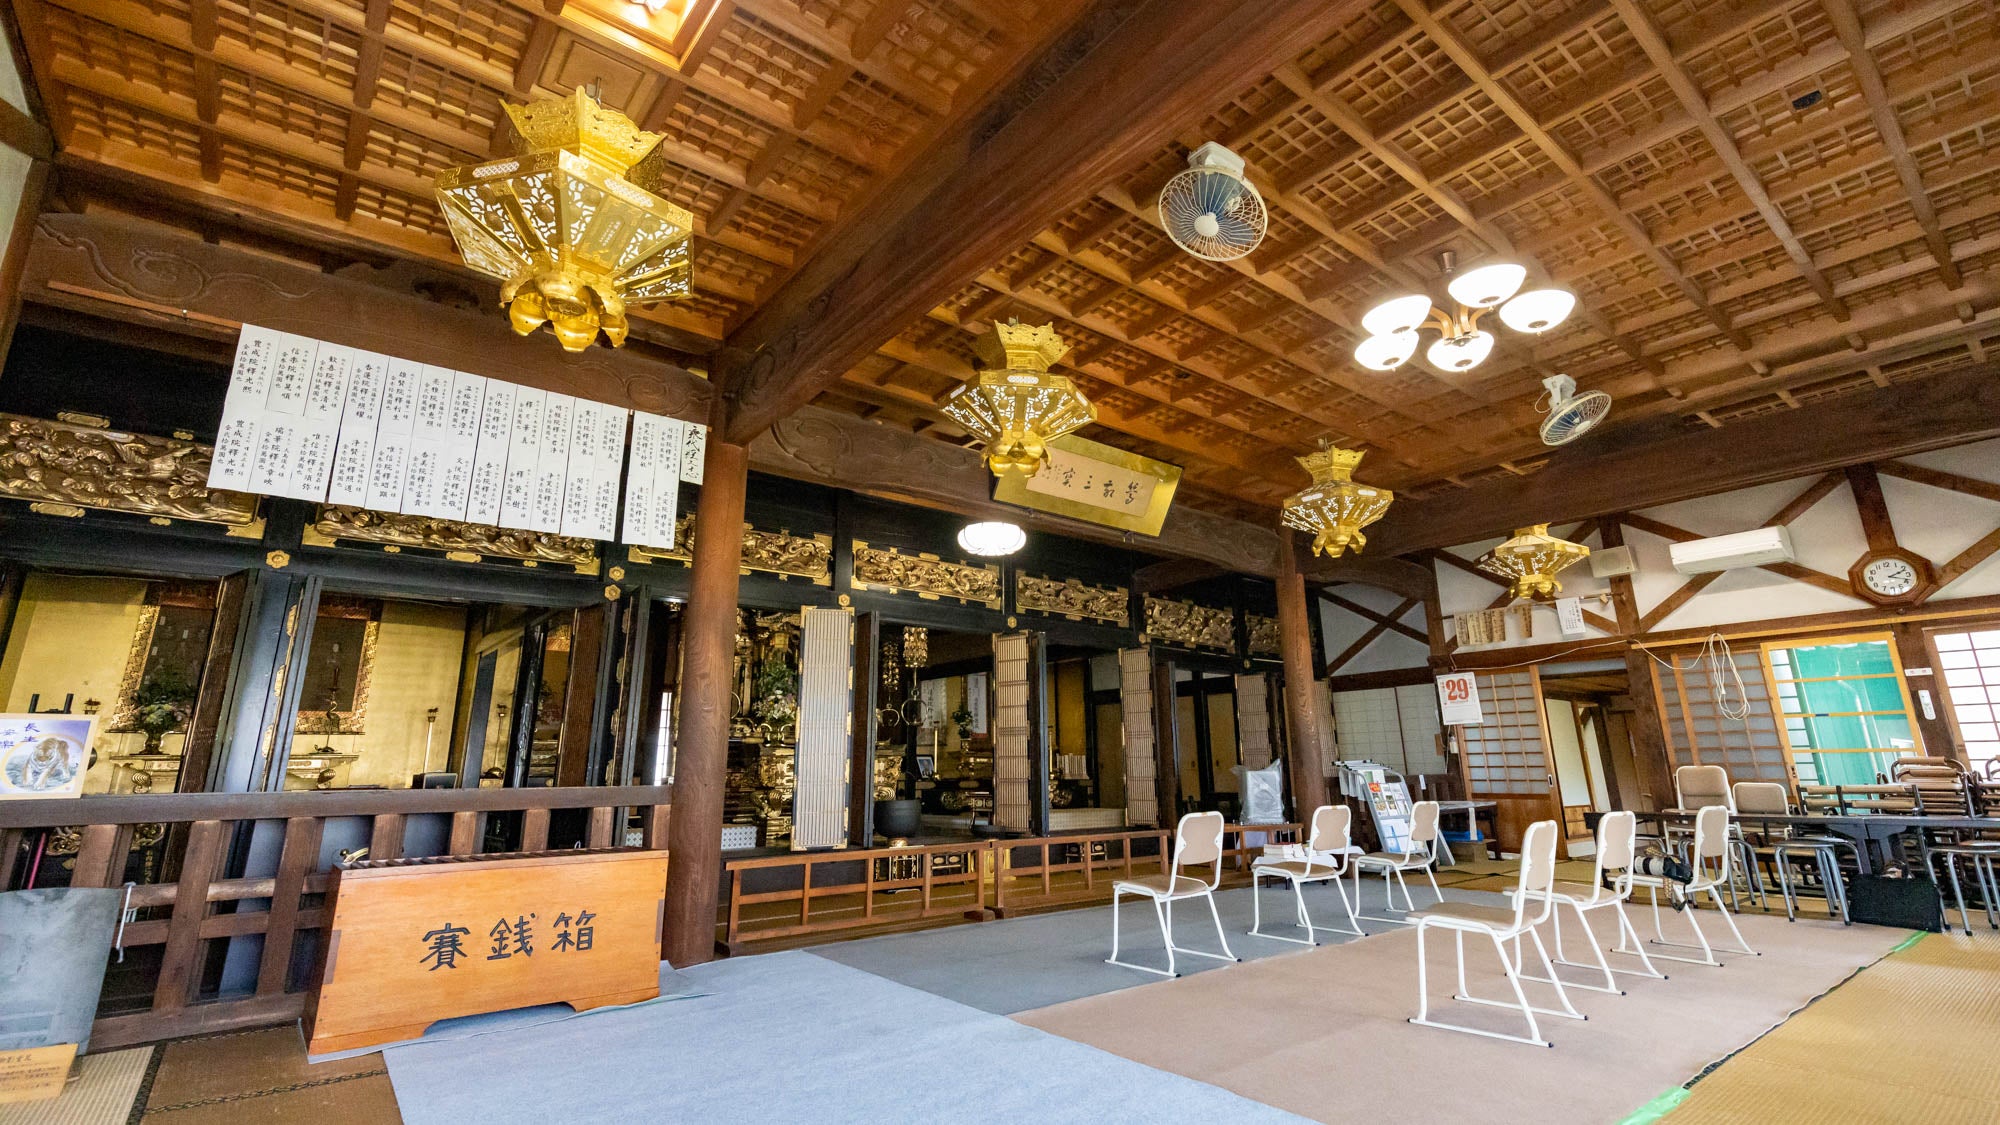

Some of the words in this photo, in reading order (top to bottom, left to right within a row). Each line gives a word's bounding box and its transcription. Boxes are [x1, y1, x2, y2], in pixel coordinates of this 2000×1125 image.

[1446, 678, 1469, 701] 29
[419, 910, 597, 972] 賽銭箱
